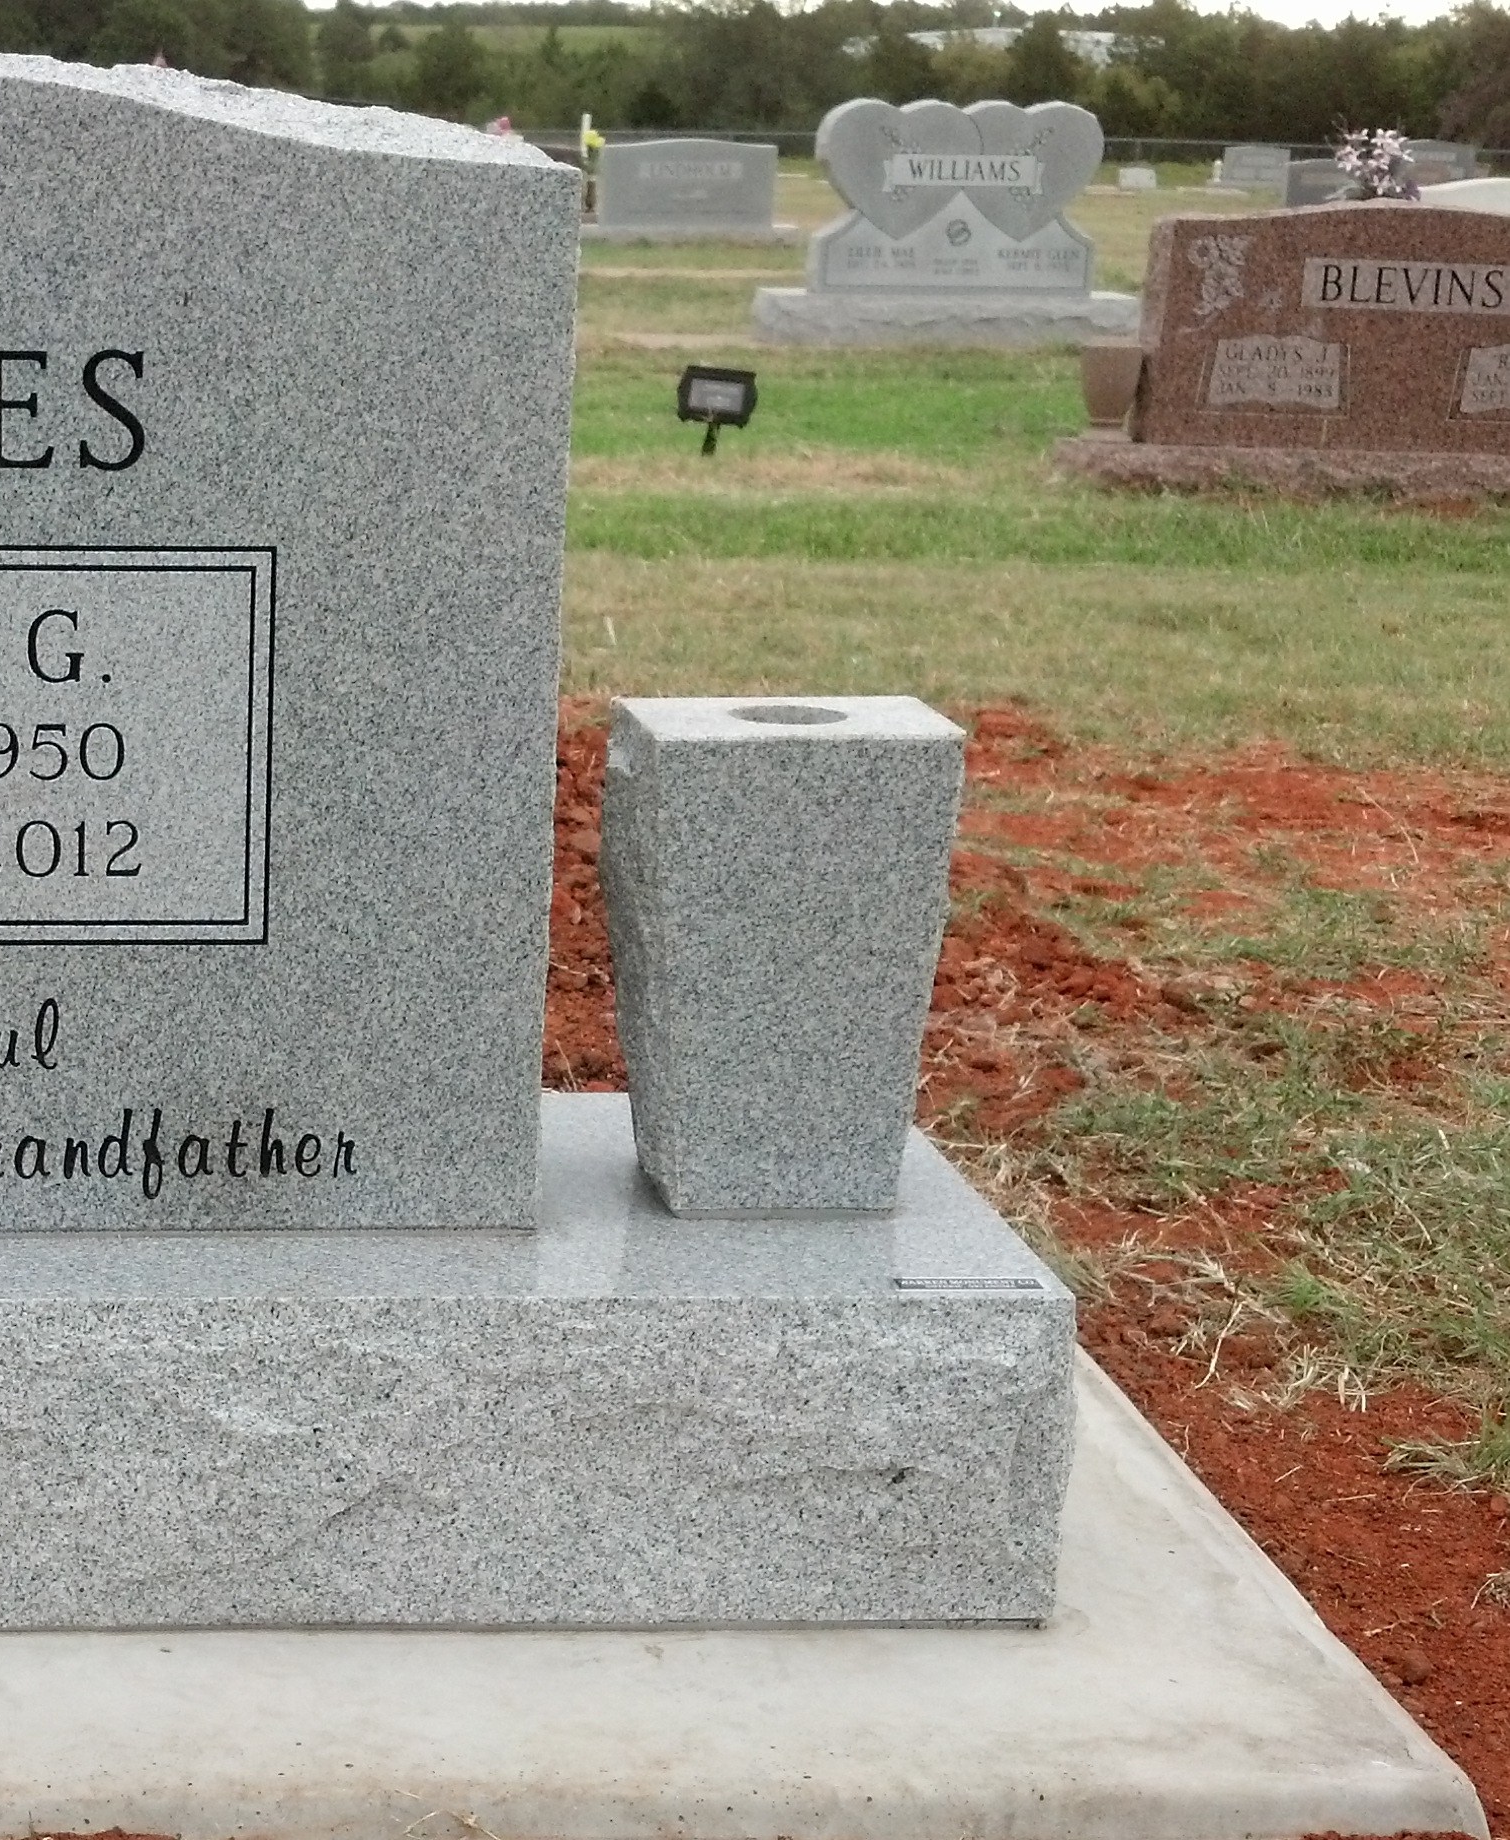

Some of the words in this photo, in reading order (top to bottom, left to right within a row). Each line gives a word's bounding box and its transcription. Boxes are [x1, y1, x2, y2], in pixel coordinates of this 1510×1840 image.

[908, 158, 1021, 183] WILLIAMS
[1321, 264, 1504, 308] BLEVINS
[1225, 343, 1303, 361] GLADYS
[27, 608, 113, 684] G.
